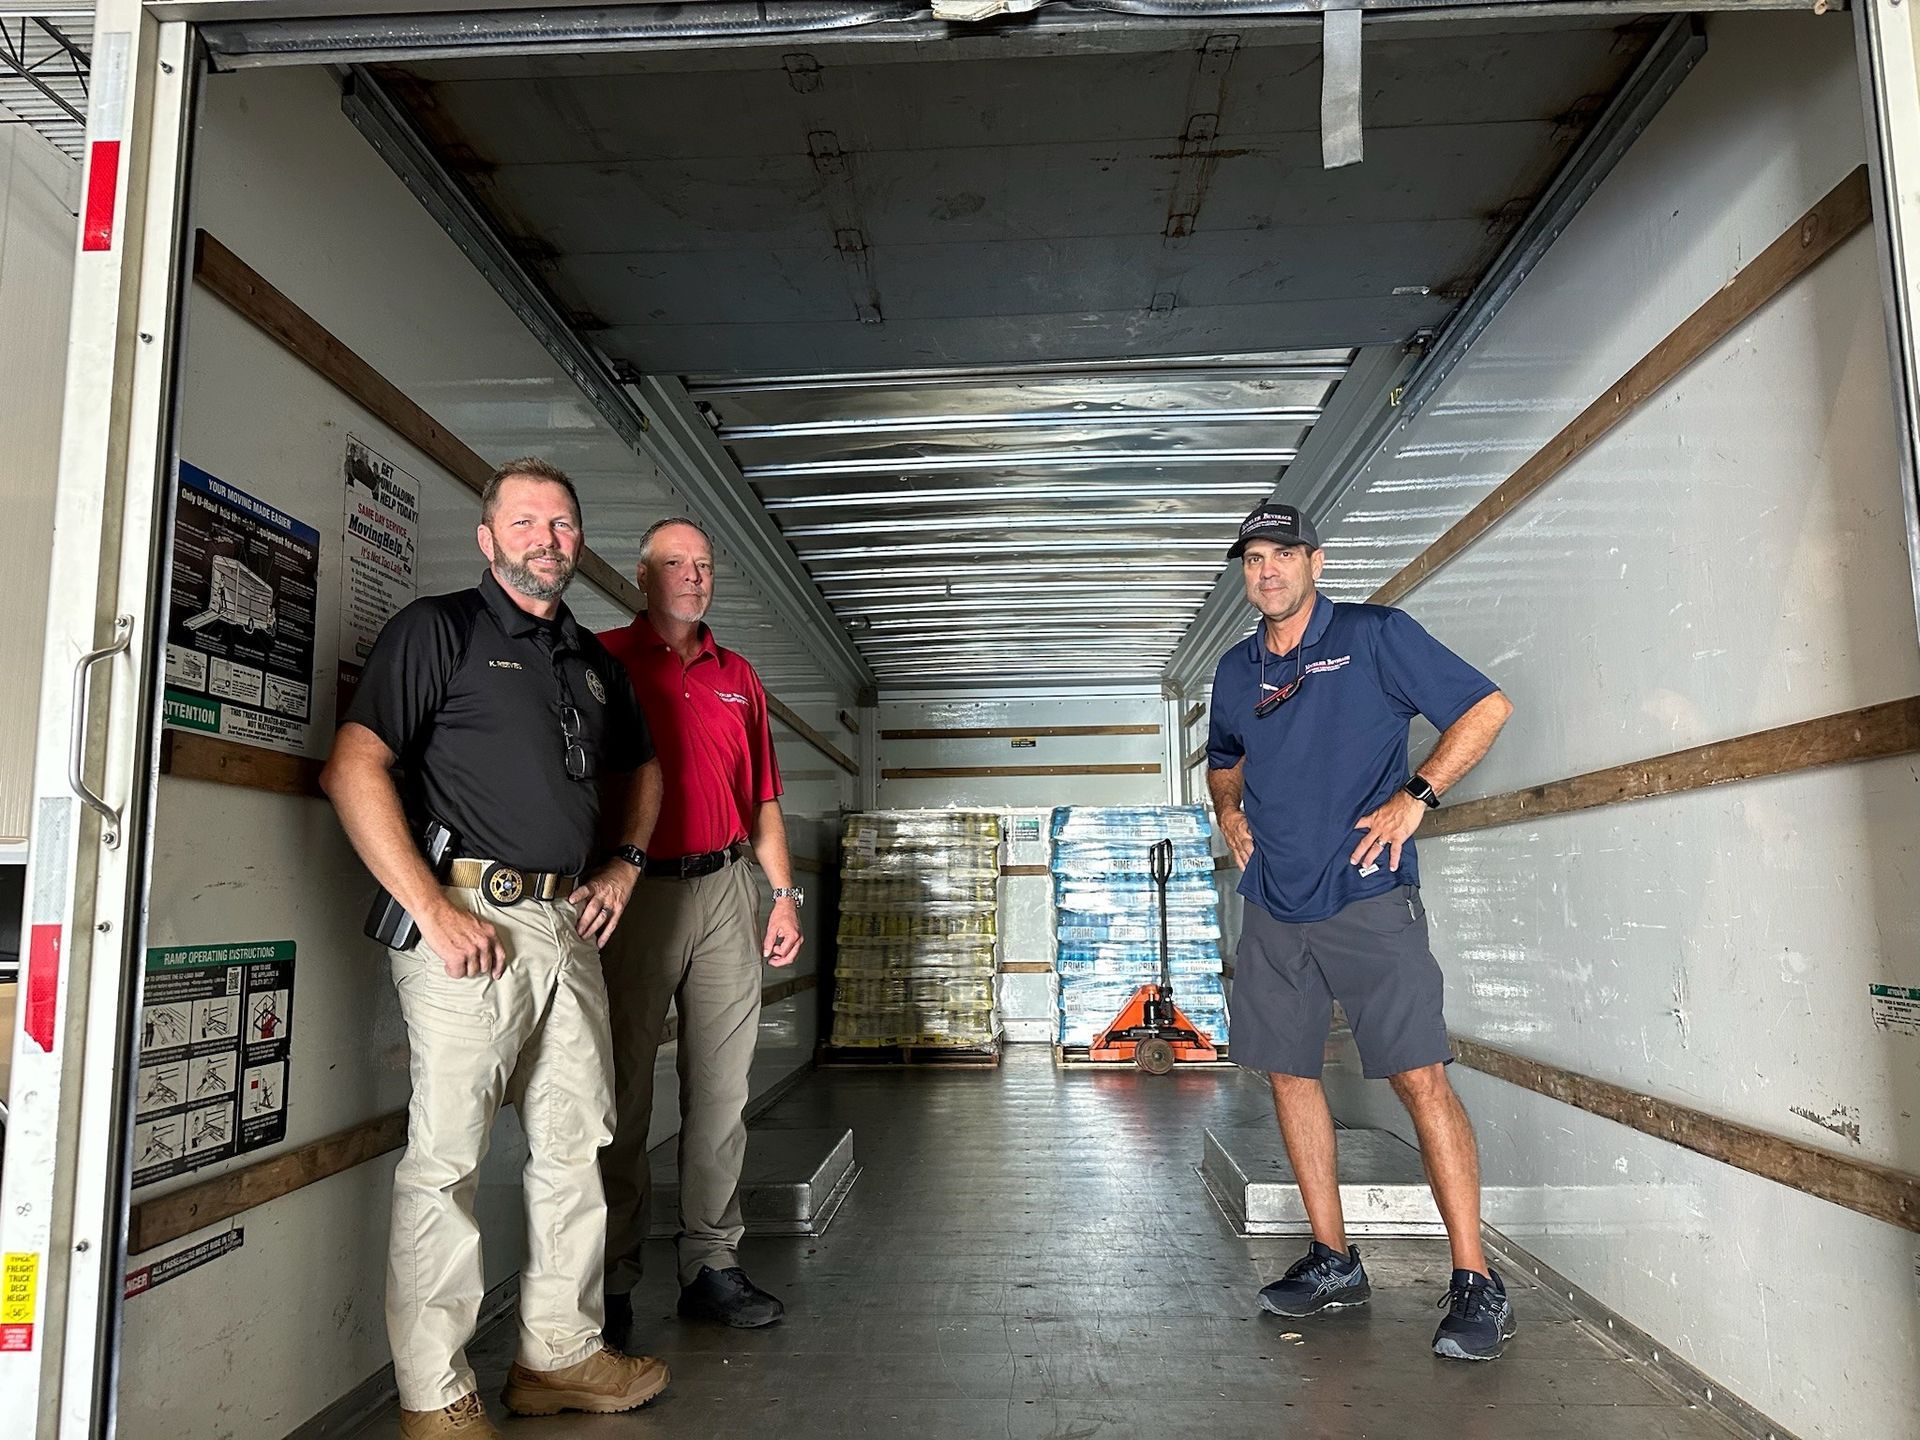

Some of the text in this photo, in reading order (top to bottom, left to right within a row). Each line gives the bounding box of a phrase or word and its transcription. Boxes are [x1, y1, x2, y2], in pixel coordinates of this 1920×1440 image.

[381, 462, 394, 478] GET
[181, 488, 196, 505] Only
[197, 496, 218, 514] U-Haul
[208, 479, 292, 530] YOUR MOVING MADE EASIER
[380, 492, 419, 524] HELP TODAY!
[358, 502, 407, 538] SAME DAY SERVICE
[360, 546, 370, 560] It's
[162, 700, 216, 725] ATTENTION
[242, 710, 258, 720] TRUCK
[164, 946, 275, 966] RAMP OPERATING INSTRUCTIONS
[10, 1284, 26, 1292] DECK
